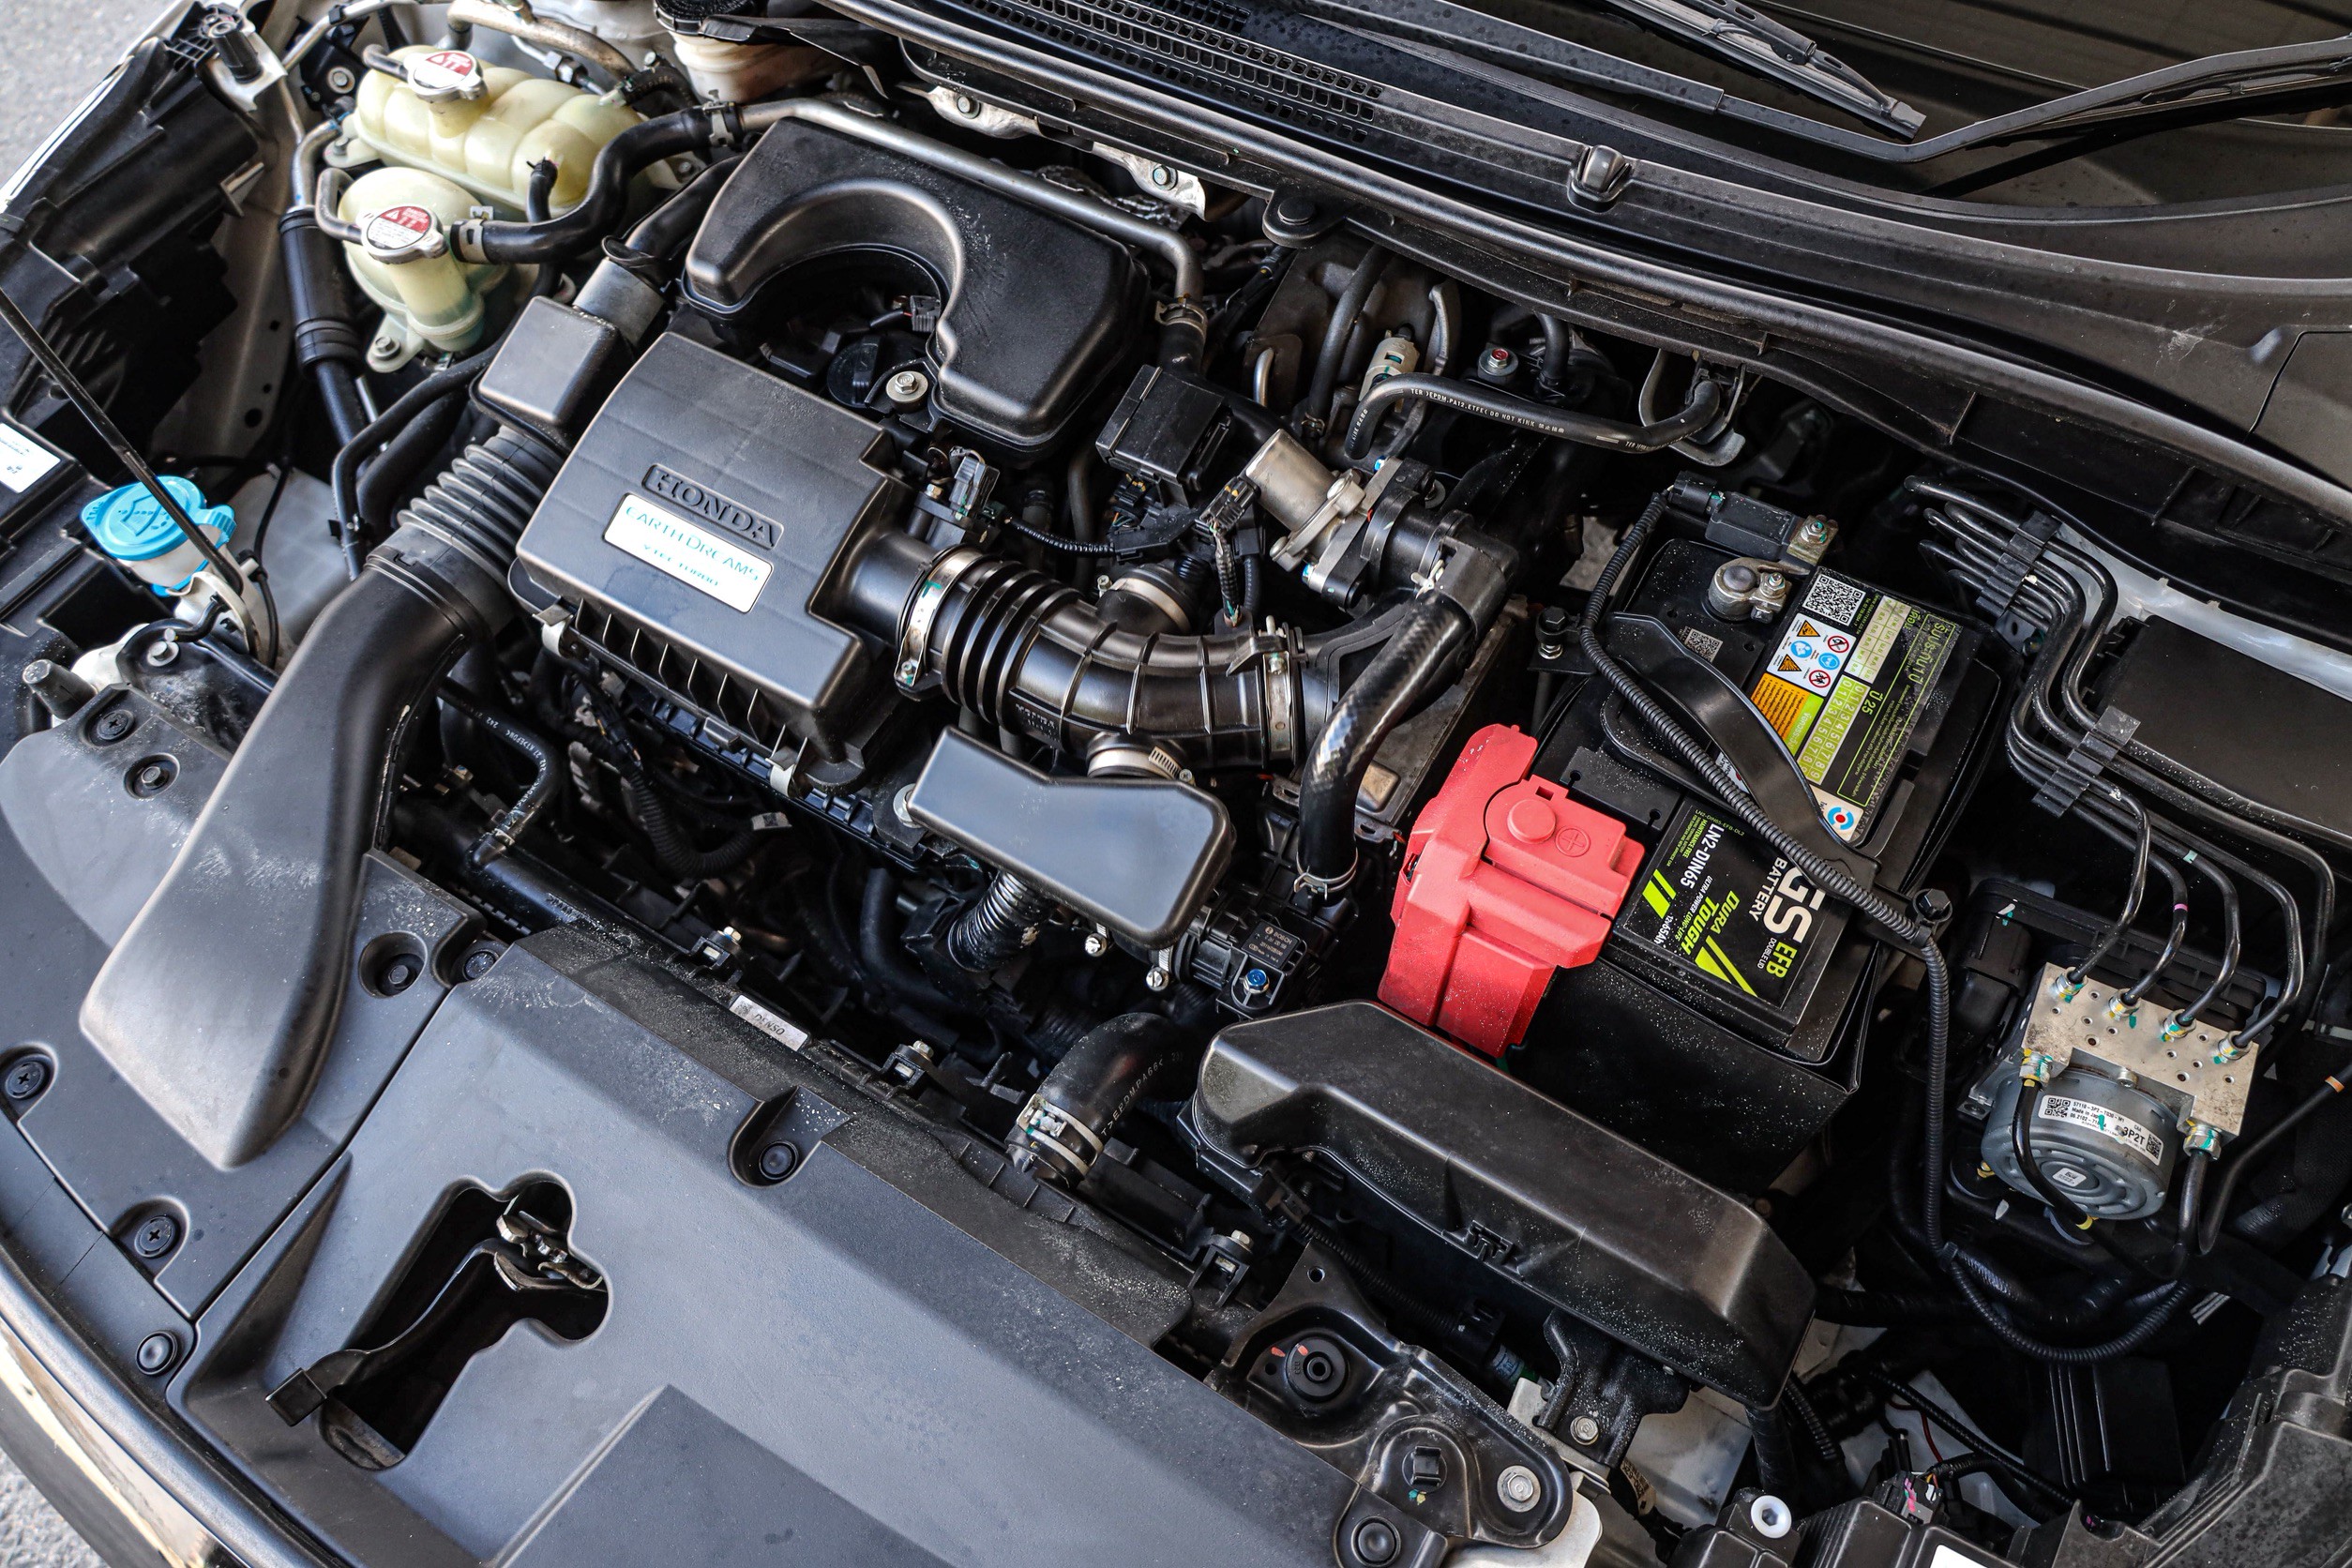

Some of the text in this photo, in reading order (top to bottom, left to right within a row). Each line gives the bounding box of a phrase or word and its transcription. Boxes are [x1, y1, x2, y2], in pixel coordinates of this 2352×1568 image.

[1409, 386, 1424, 397] TER
[1500, 413, 1515, 422] NOT
[1516, 416, 1535, 427] KINK
[655, 469, 775, 547] HONDA
[626, 505, 759, 580] EARTH DREAMS
[1836, 687, 1847, 698] 1
[1841, 677, 1852, 688] 0
[1826, 706, 1838, 716] 3
[1832, 697, 1843, 707] 2
[1859, 697, 1877, 716] 25
[486, 716, 498, 728] 242
[1809, 683, 1864, 779] 0 1 2 3 4 5 6 7 8 9
[1817, 725, 1829, 735] 5
[1822, 716, 1833, 726] 4
[1807, 744, 1818, 754] 7
[1812, 734, 1823, 745] 6
[1802, 754, 1813, 764] 8
[1681, 818, 1708, 859] MAINTENANCE FREE
[1680, 823, 1724, 888] LN2-DIN65
[1748, 857, 1787, 921] BATTERY
[1674, 875, 1712, 941] ULTRA POWER LONG-LIFE
[1710, 890, 1740, 934] DURA
[1679, 896, 1719, 955] TOUGH
[1763, 867, 1825, 977] GS EFB
[1274, 930, 1293, 945] BOSCH
[1760, 937, 1776, 960] DOUBLE
[753, 1014, 785, 1035] DENSO
[2072, 1106, 2084, 1115] Made
